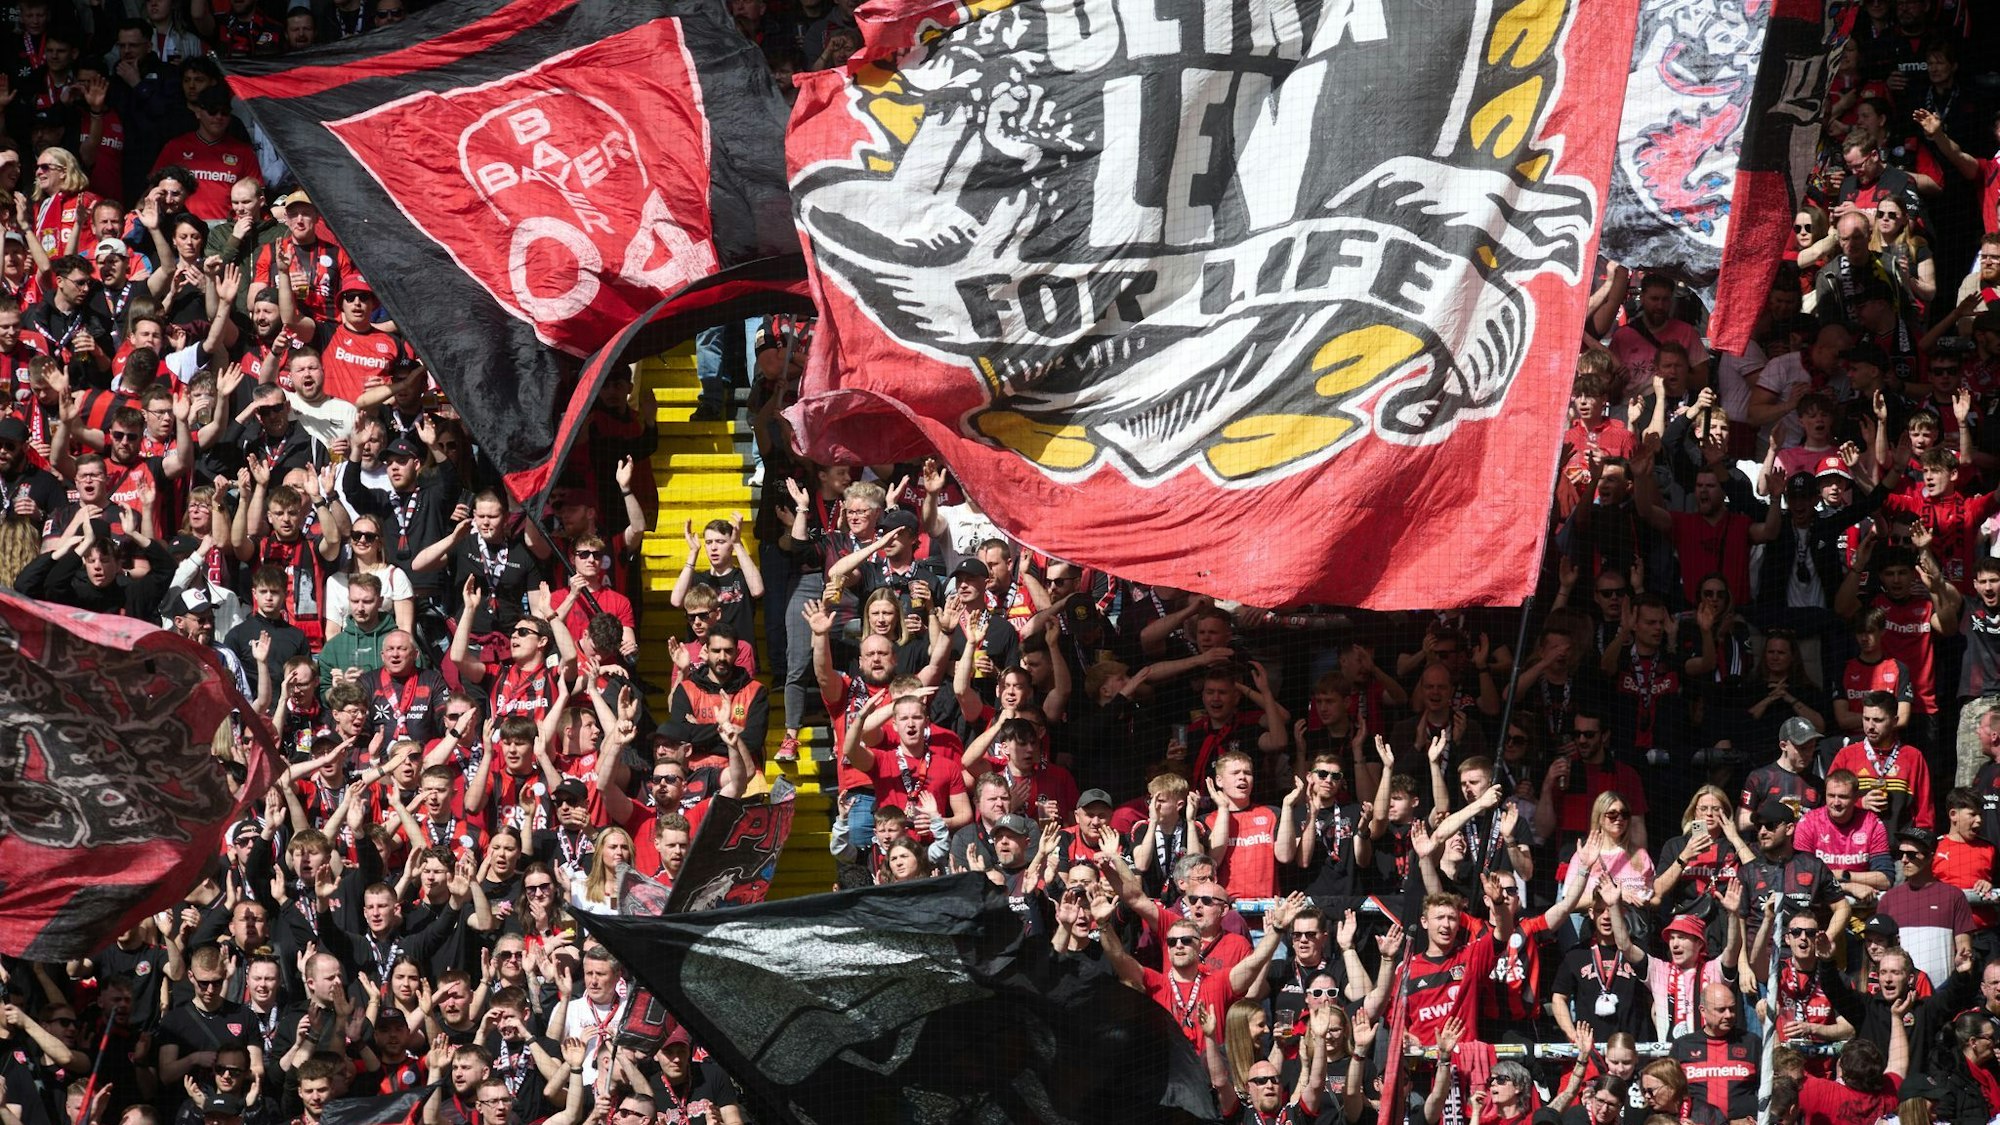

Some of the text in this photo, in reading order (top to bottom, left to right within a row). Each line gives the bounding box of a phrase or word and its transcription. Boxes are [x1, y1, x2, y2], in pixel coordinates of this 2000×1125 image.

[189, 169, 237, 185] armenia
[1089, 60, 1328, 248] LEV
[955, 229, 1453, 340] FOR LIFE
[1685, 1064, 1749, 1081] Barmenia
